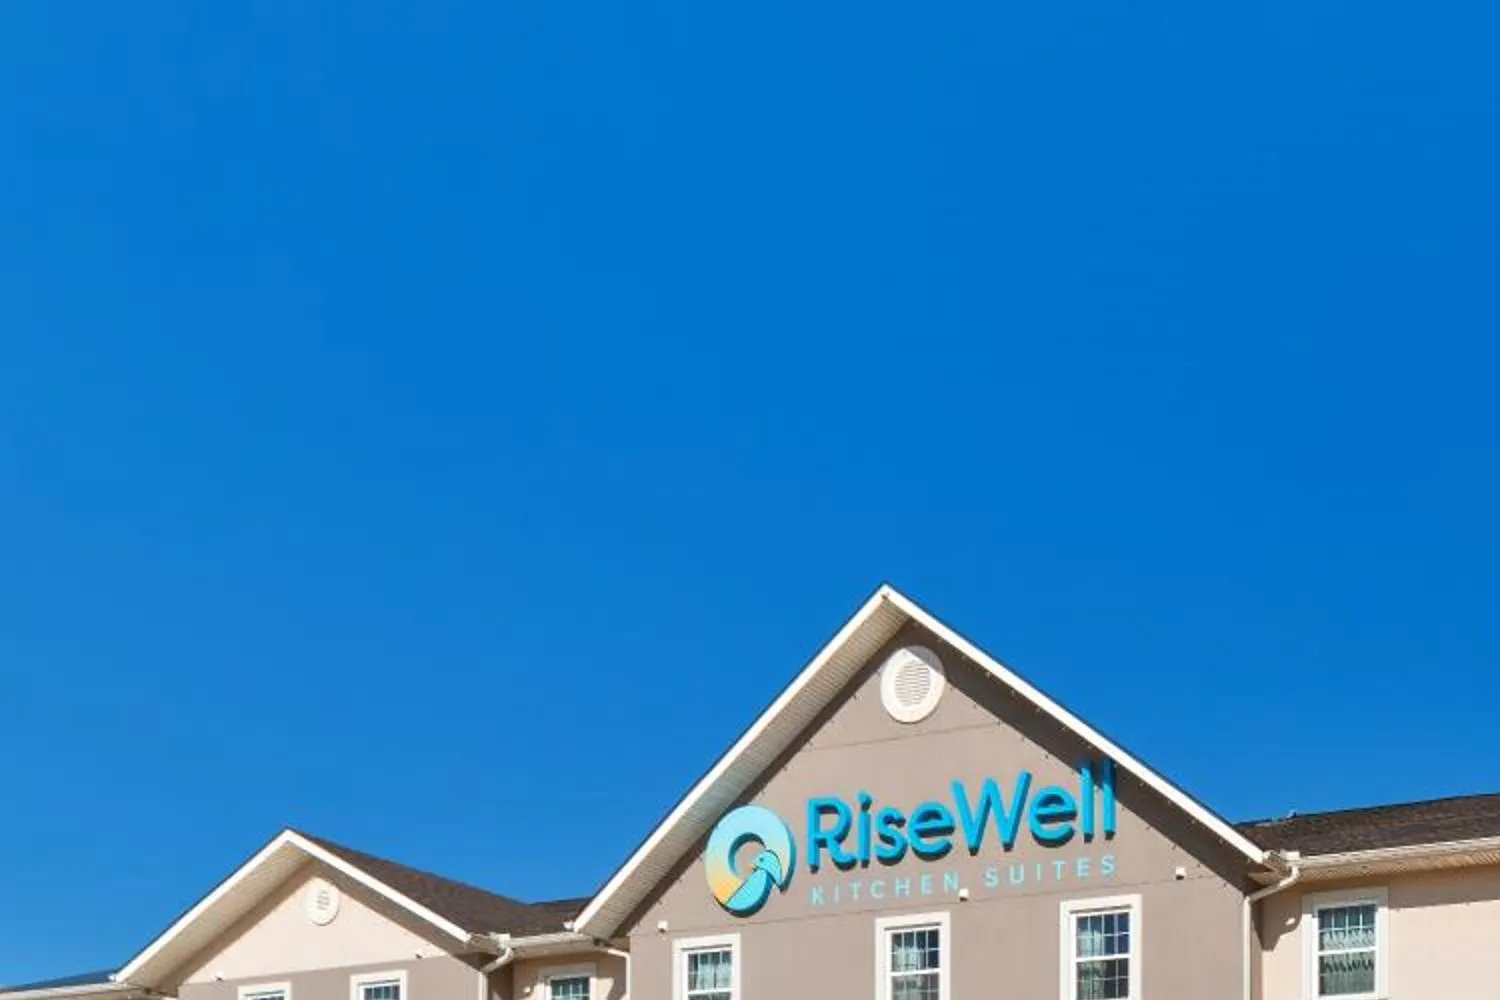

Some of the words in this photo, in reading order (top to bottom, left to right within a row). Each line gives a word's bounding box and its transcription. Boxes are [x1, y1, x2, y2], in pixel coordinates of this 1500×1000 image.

[806, 758, 1117, 872] RiseWell
[811, 876, 960, 905] KITCHEN
[983, 854, 1117, 887] SUITES
